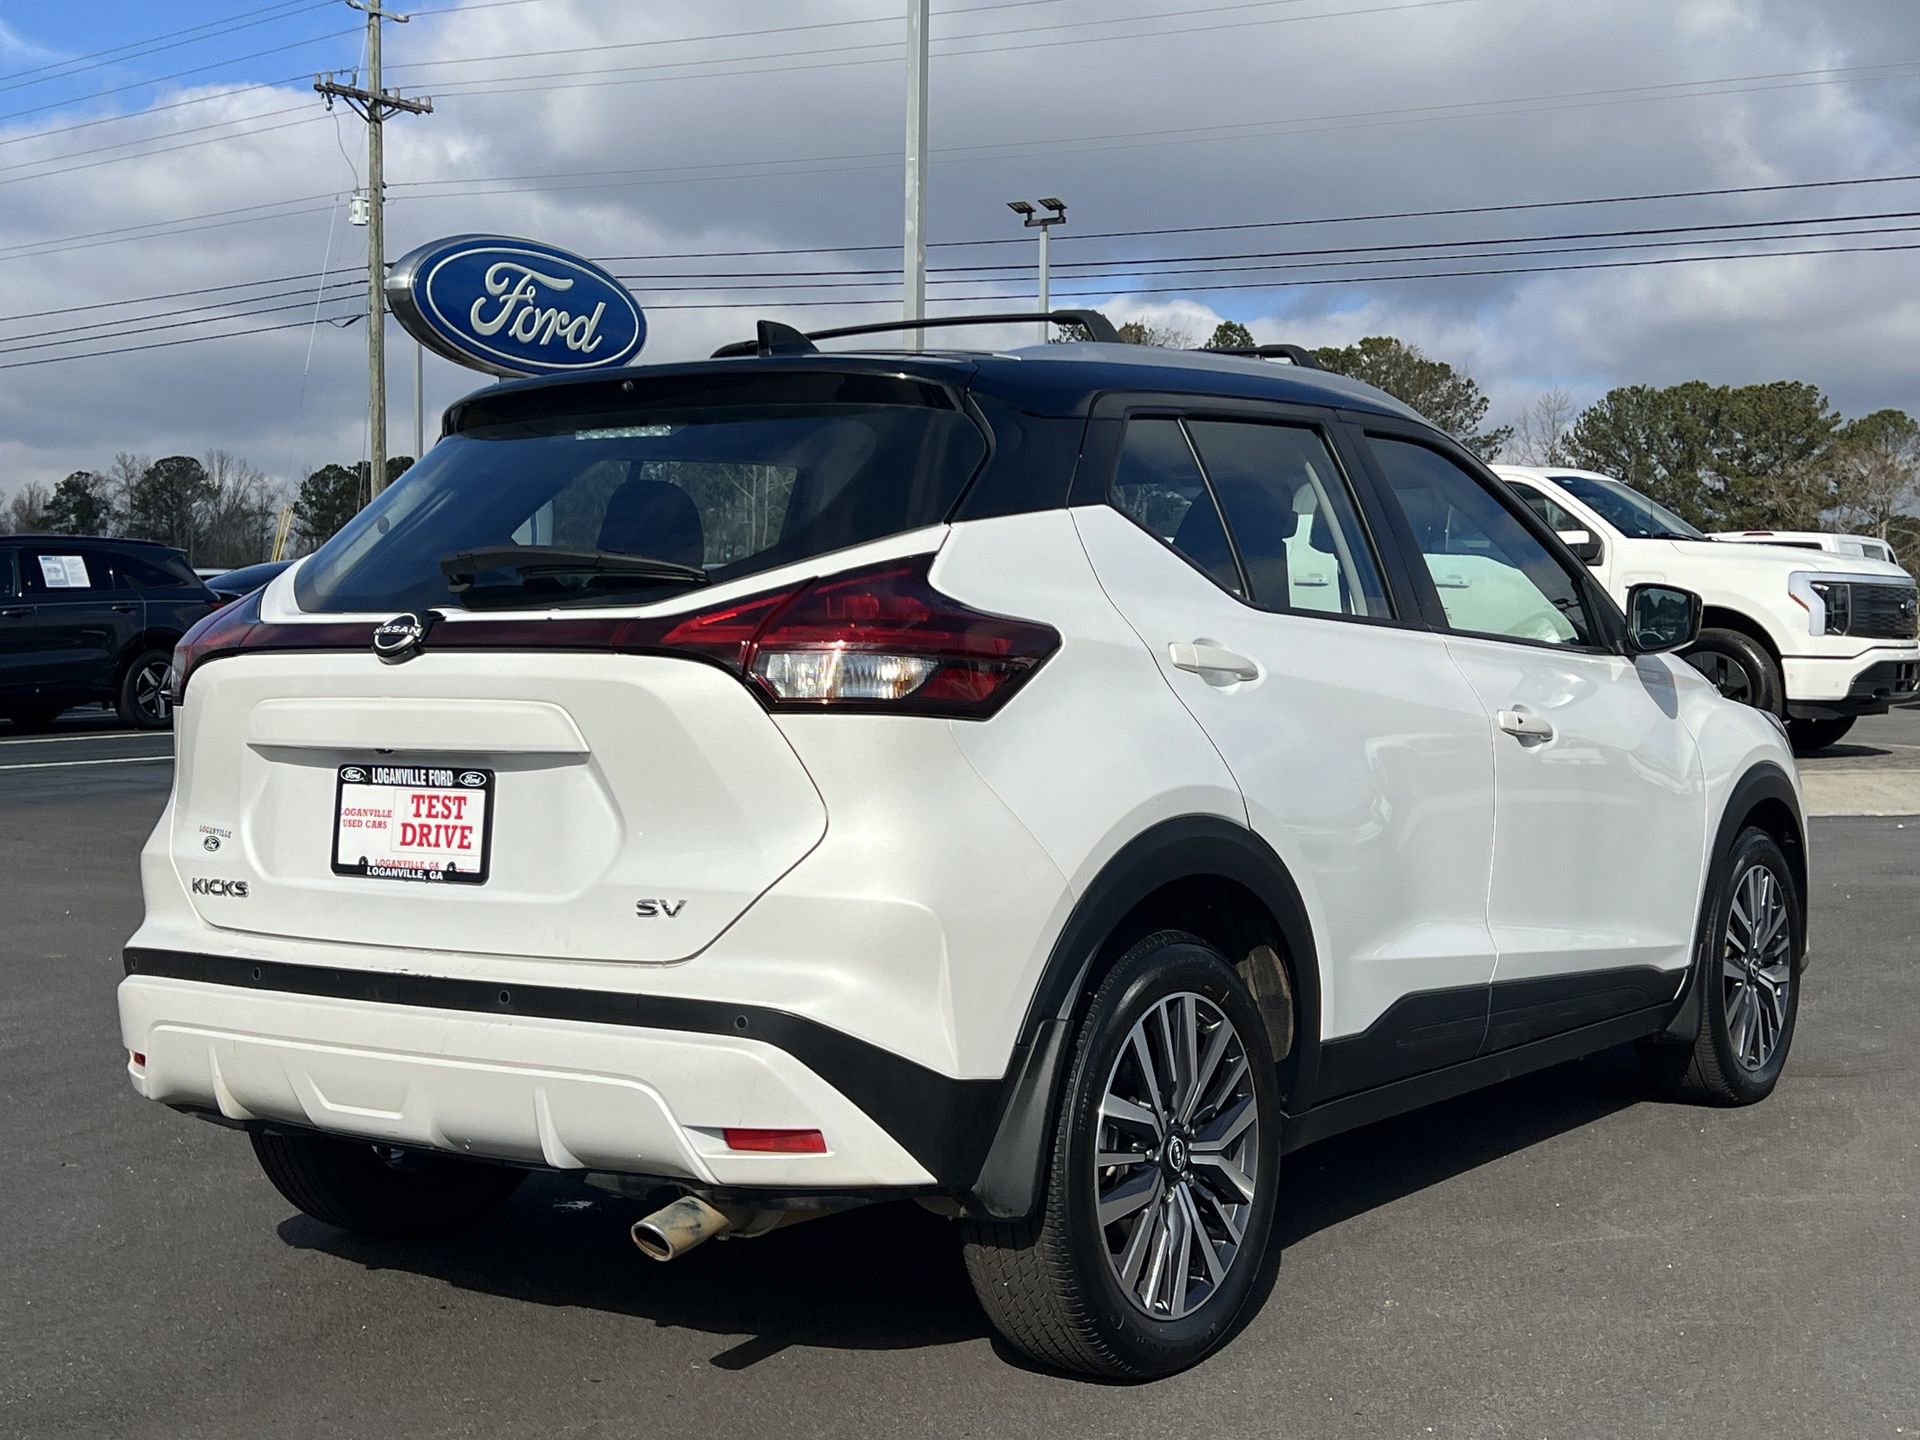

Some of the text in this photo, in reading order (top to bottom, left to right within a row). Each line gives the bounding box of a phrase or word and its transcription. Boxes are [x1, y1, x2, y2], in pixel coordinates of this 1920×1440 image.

[470, 262, 606, 353] Ford
[374, 625, 423, 637] NISSAN
[372, 767, 454, 786] LOGANVILLE FORD
[411, 794, 467, 820] TEST
[343, 819, 388, 829] USED CARS
[400, 822, 473, 850] DRIVE
[366, 866, 444, 881] LOGANVILLE, GA
[192, 877, 249, 898] KICKS
[636, 898, 688, 918] SV
